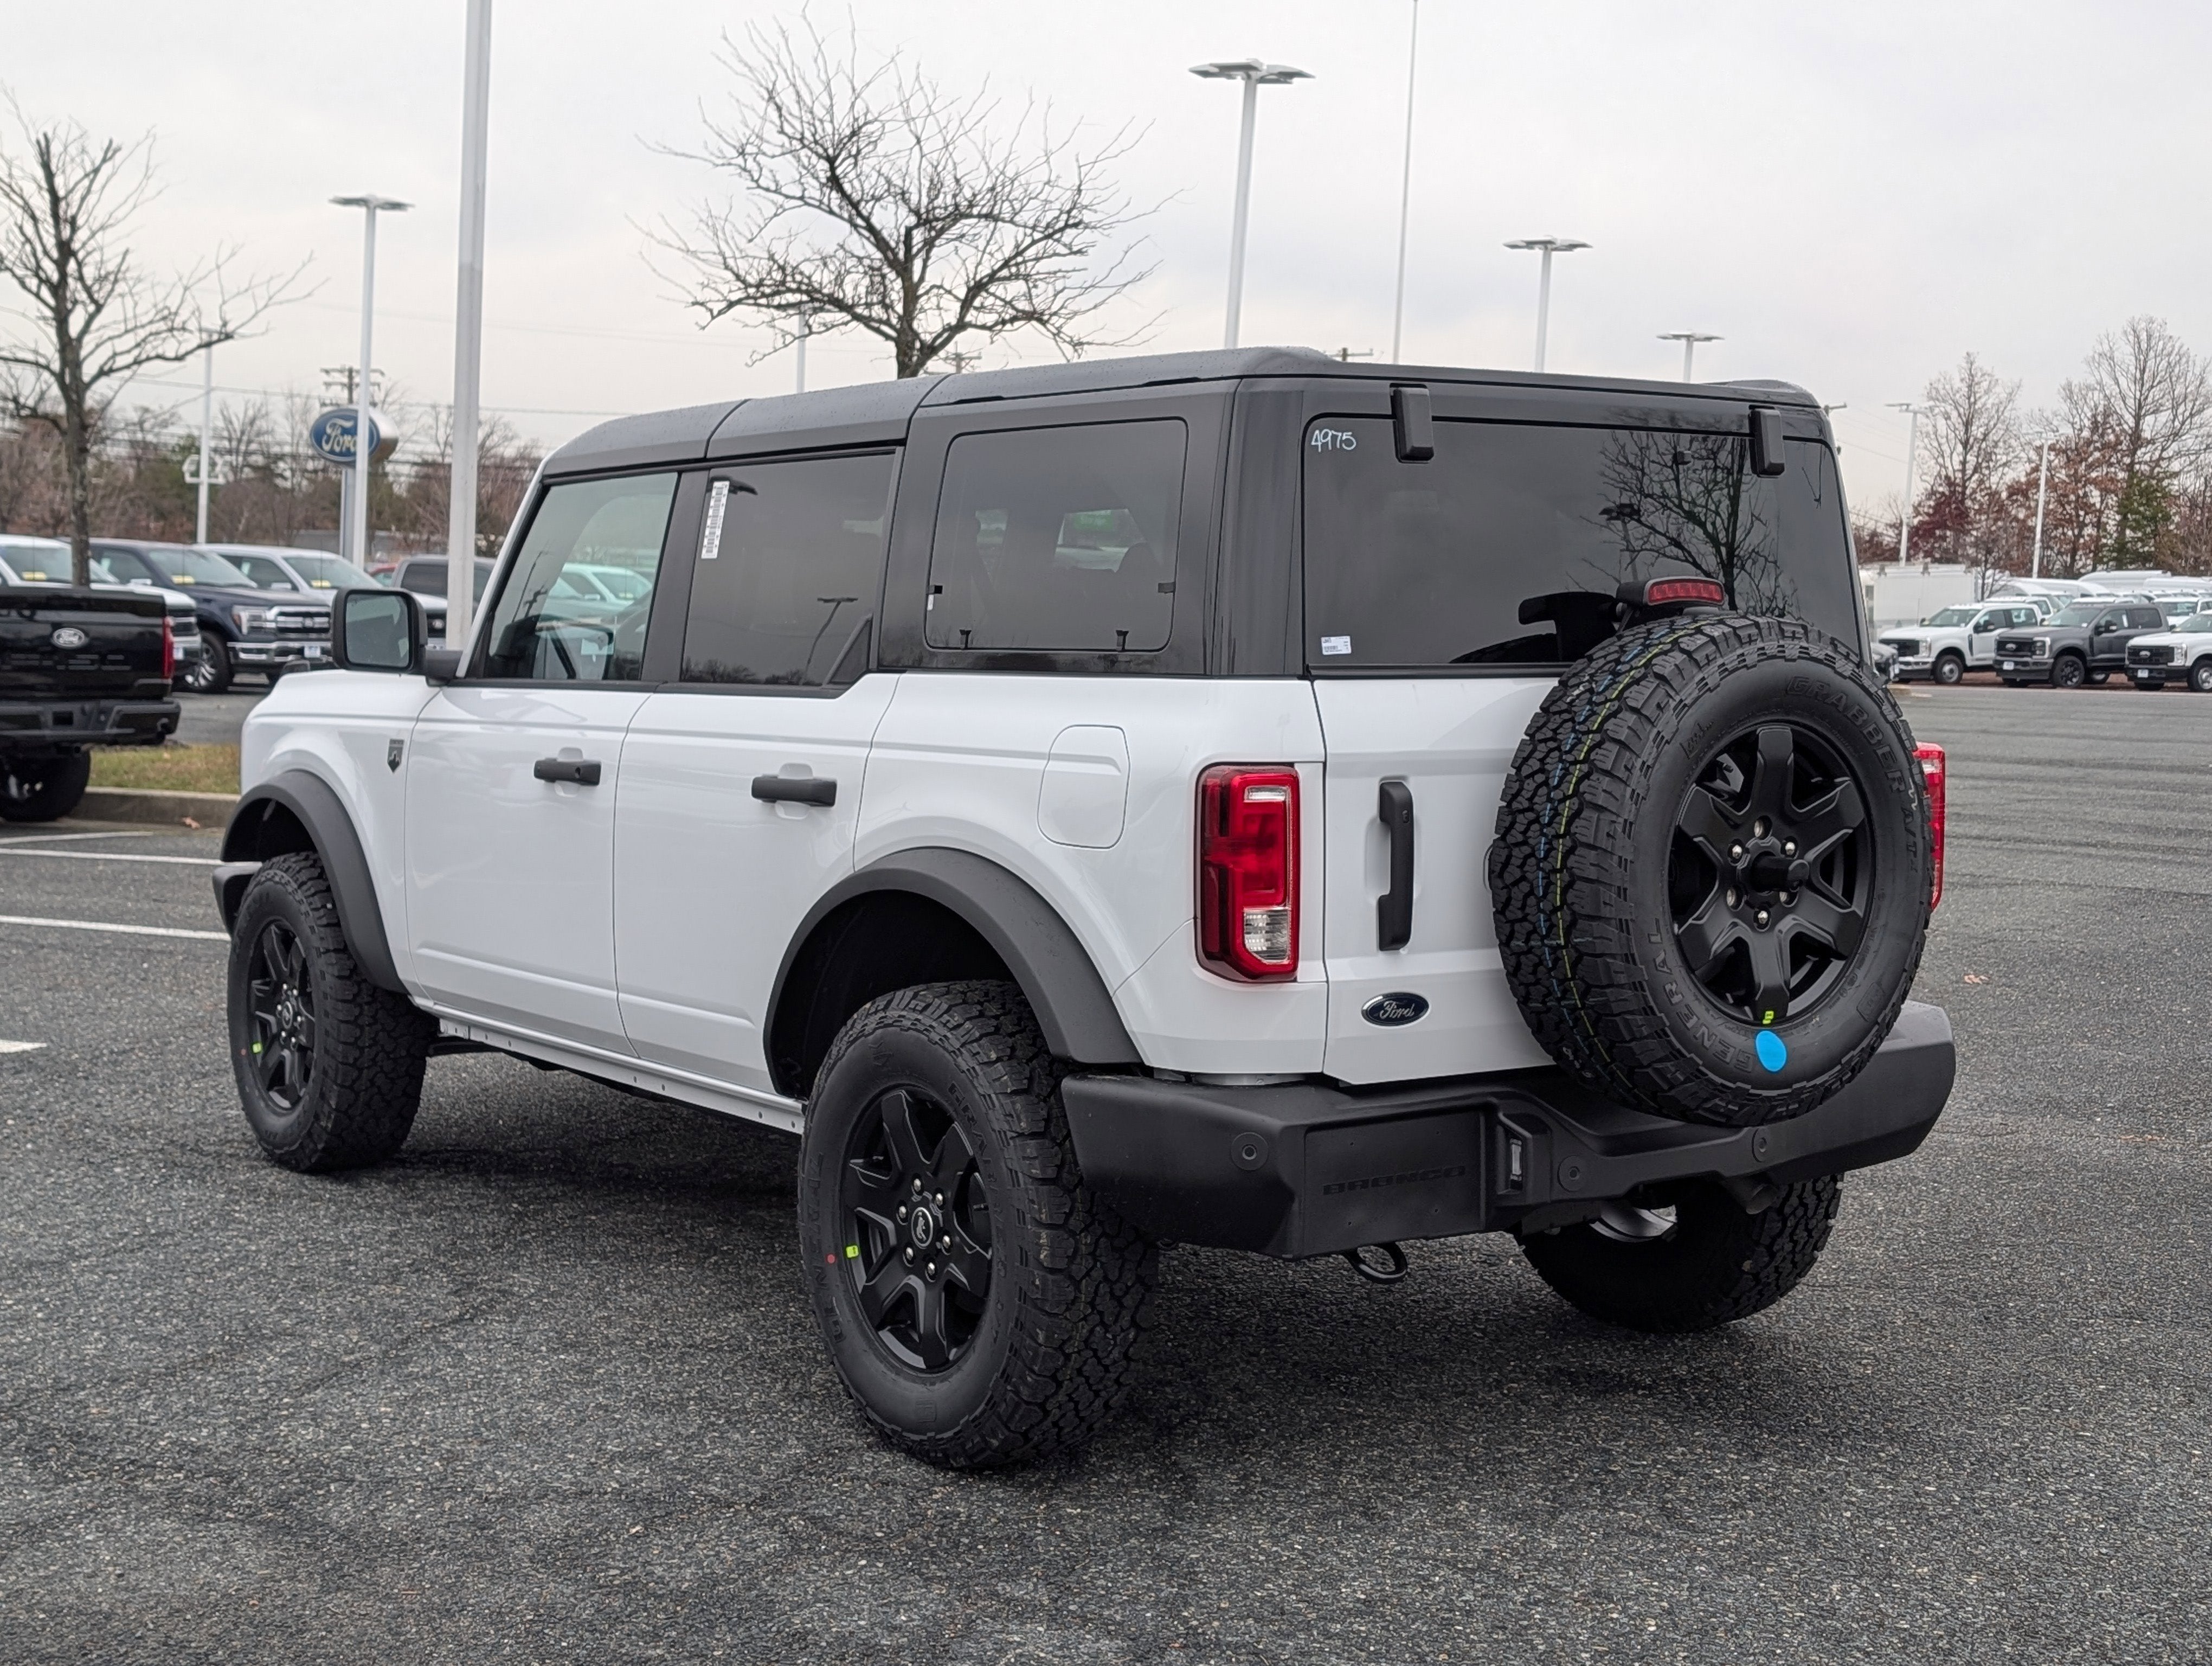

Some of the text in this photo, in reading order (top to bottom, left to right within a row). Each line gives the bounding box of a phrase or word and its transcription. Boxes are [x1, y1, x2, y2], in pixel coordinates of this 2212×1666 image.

[1311, 429, 1356, 452] 4975
[1786, 676, 1906, 793] GRABBER
[1379, 1000, 1416, 1020] Ford
[1648, 918, 1756, 1074] GENERAL
[1323, 1165, 1465, 1195] BRONCO
